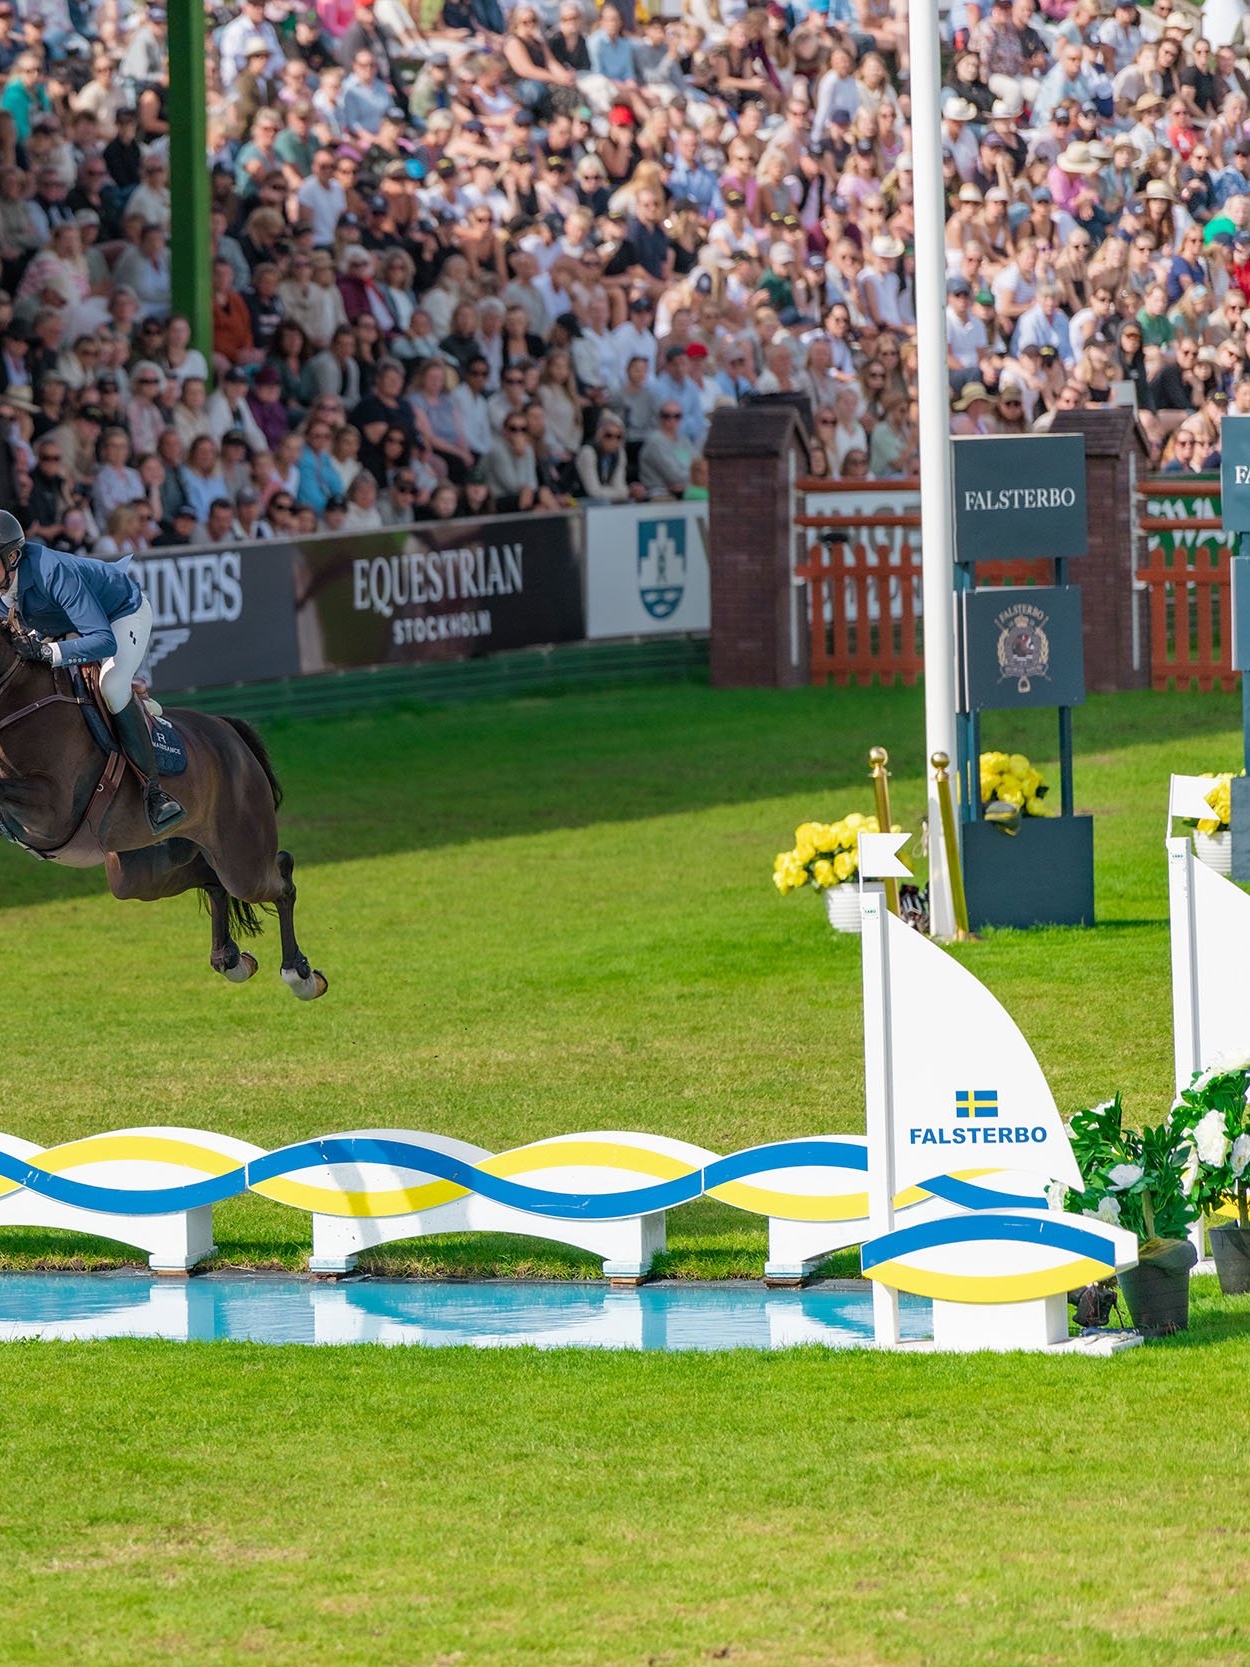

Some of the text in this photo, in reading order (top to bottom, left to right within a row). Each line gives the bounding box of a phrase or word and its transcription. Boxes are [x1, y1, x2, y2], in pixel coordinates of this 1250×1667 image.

[964, 486, 1076, 511] FALSTERBO
[352, 542, 524, 618] EQUESTRIAN
[998, 603, 1045, 623] FALSTERBO
[392, 609, 493, 645] STOCKHOLM
[909, 1126, 1048, 1145] FALSTERBO
